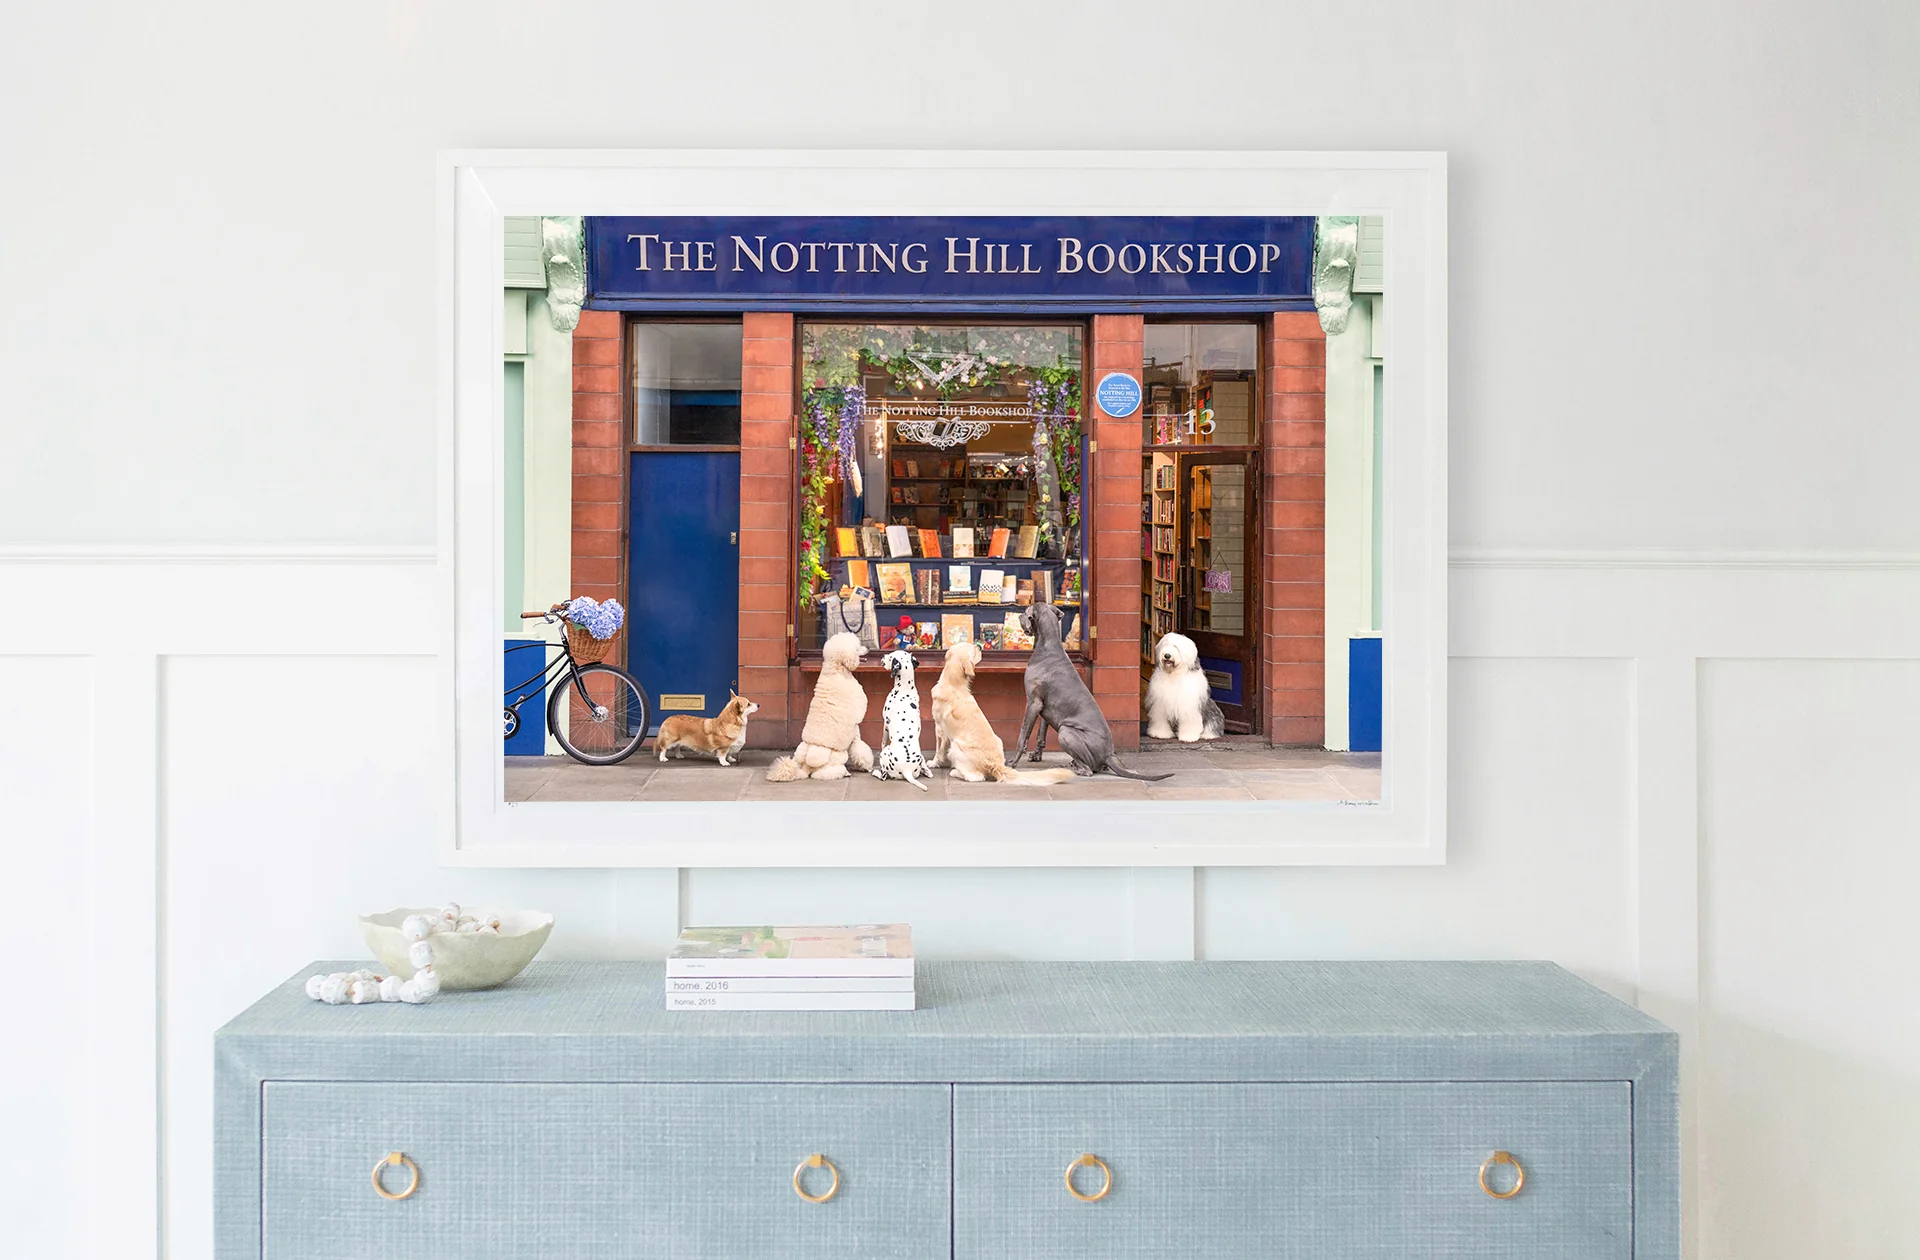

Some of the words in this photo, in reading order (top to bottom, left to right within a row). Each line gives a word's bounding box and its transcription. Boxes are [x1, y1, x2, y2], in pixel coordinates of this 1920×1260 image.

[625, 233, 718, 272] THE
[730, 235, 929, 274] NOTTING
[944, 237, 1042, 274] HILL
[1056, 237, 1281, 275] BOOKSHOP
[854, 404, 878, 416] THE
[881, 404, 936, 416] NOTTING
[939, 405, 966, 416] HILL
[969, 405, 1032, 417] BOOKSHOP
[1184, 408, 1216, 435] 13
[705, 981, 729, 990] 2016
[698, 998, 716, 1006] 2015
